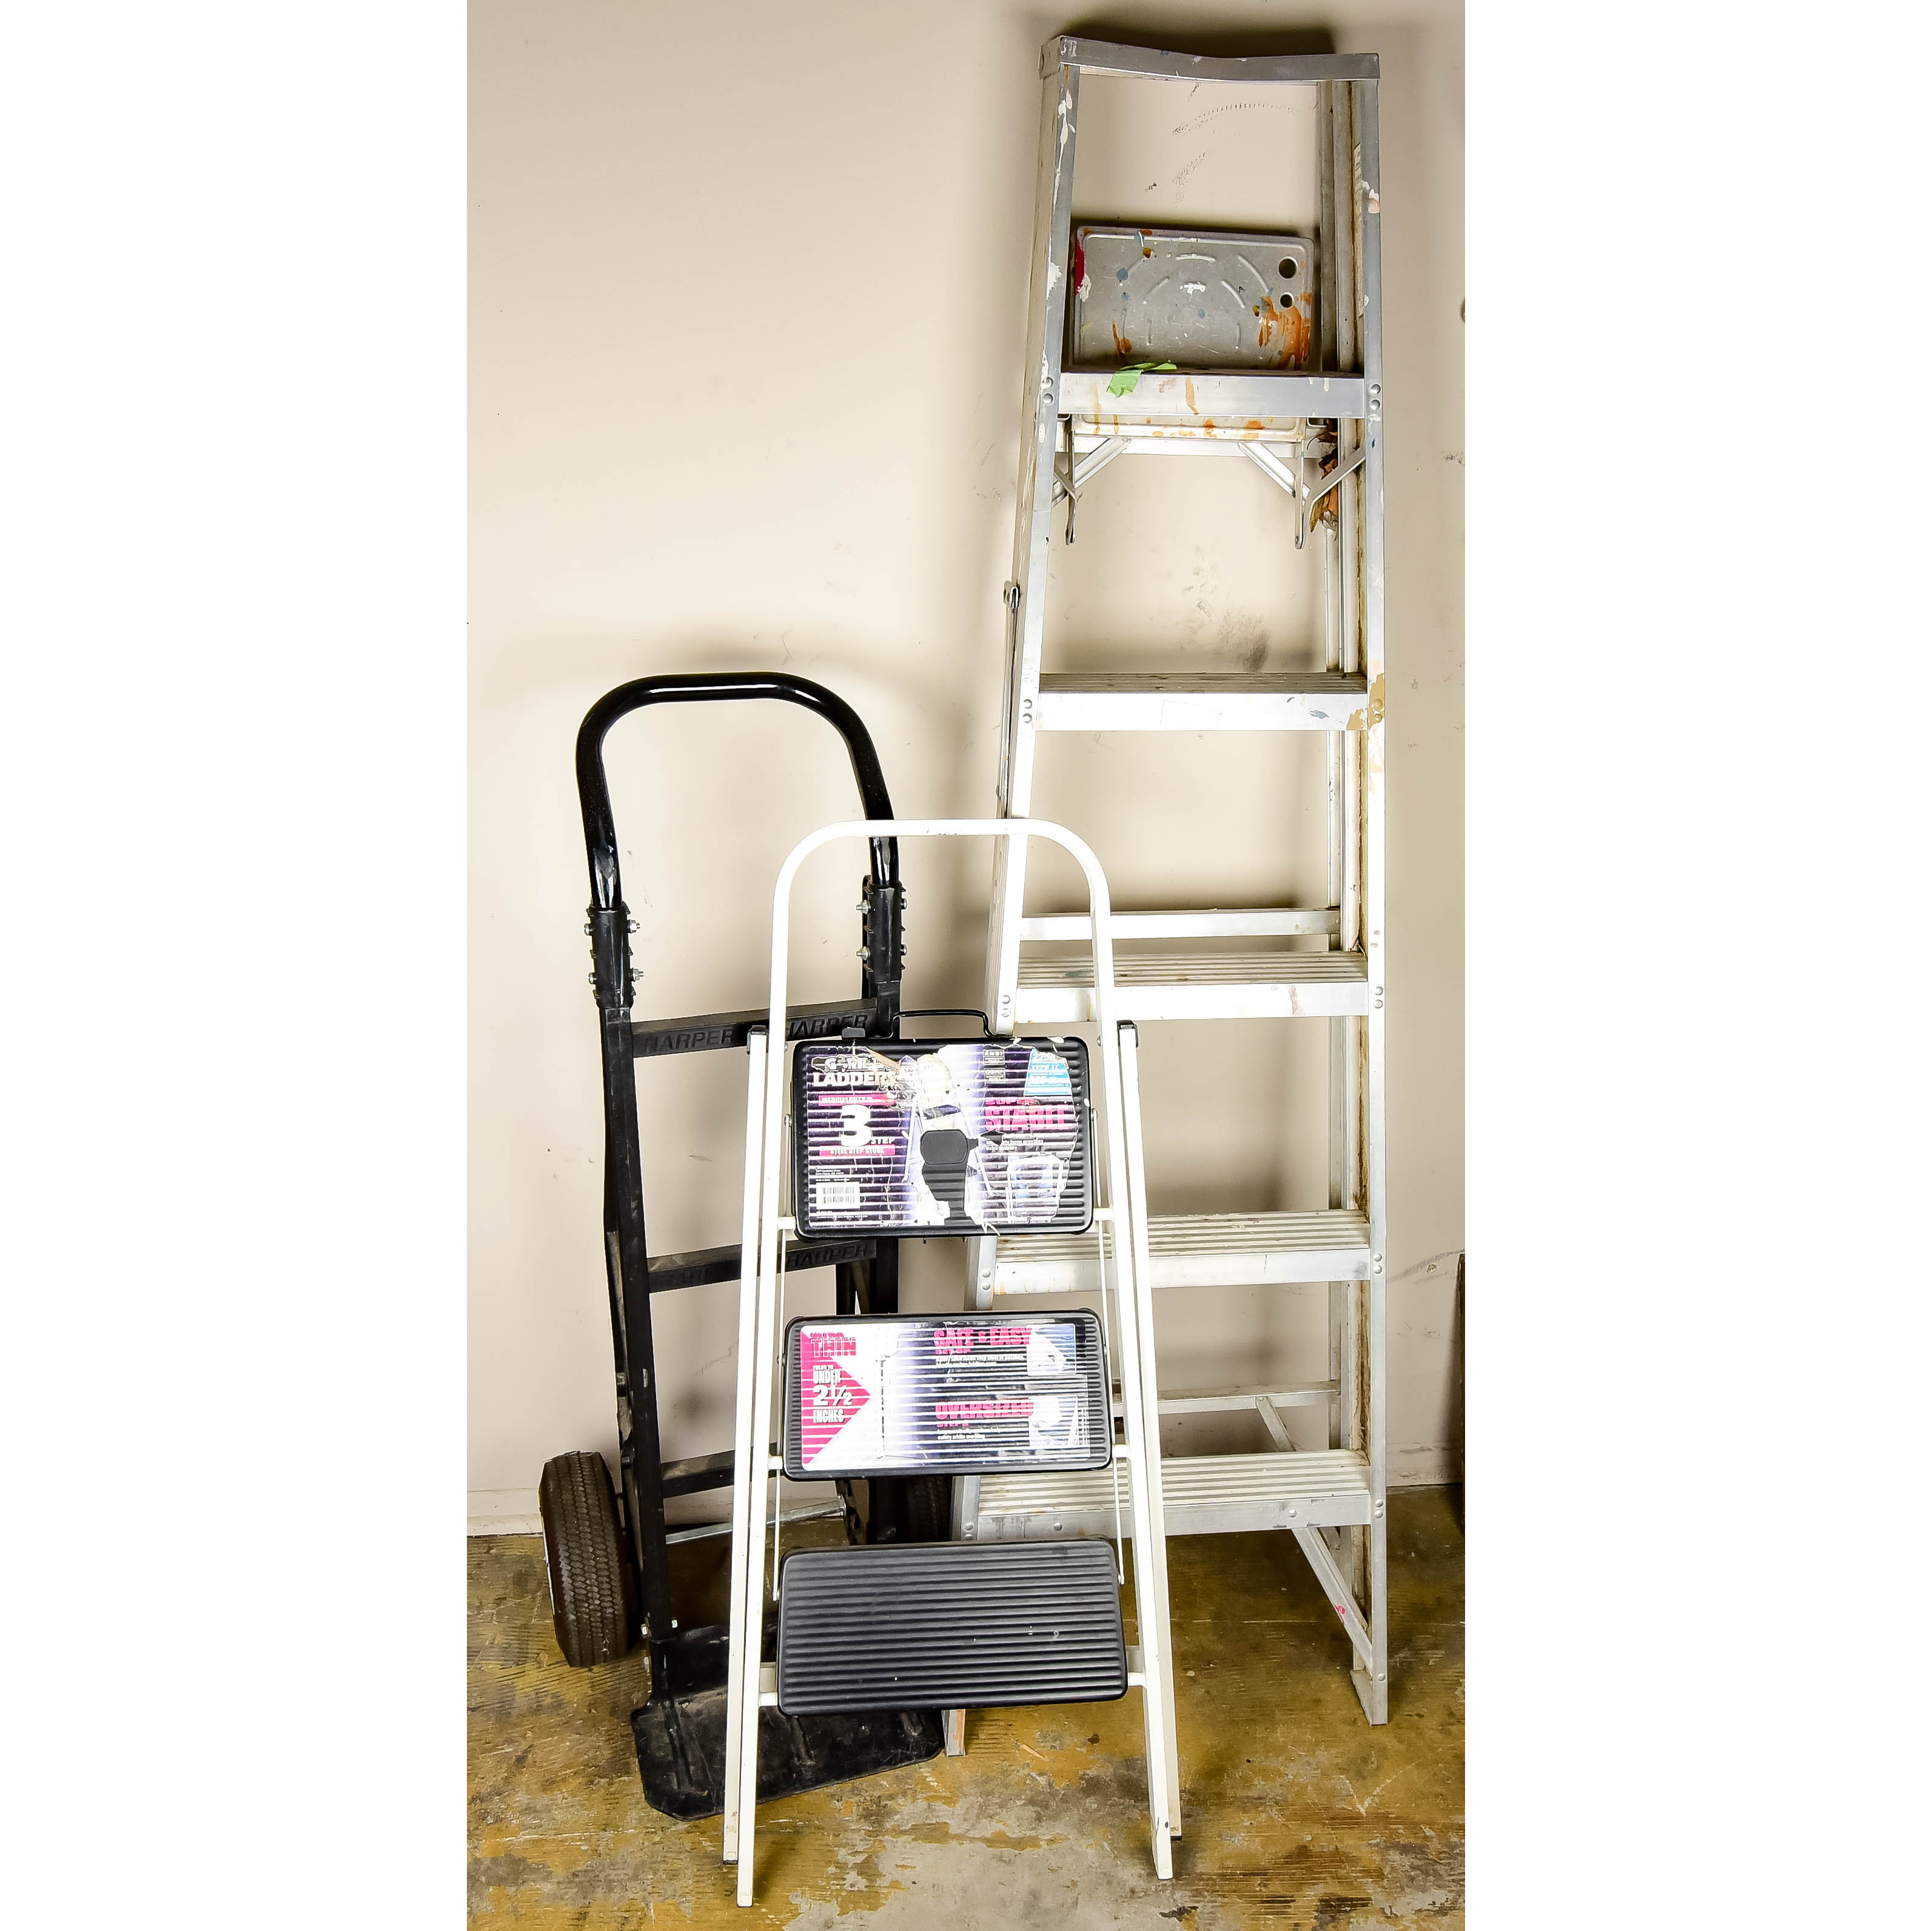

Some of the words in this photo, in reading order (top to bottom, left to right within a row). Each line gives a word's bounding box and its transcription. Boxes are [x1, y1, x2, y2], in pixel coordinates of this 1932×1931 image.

[643, 1030, 733, 1052] HARPER
[840, 1104, 871, 1147] 3
[810, 1337, 856, 1357] THIN
[813, 1369, 841, 1384] UNDER
[813, 1408, 844, 1424] INCHES
